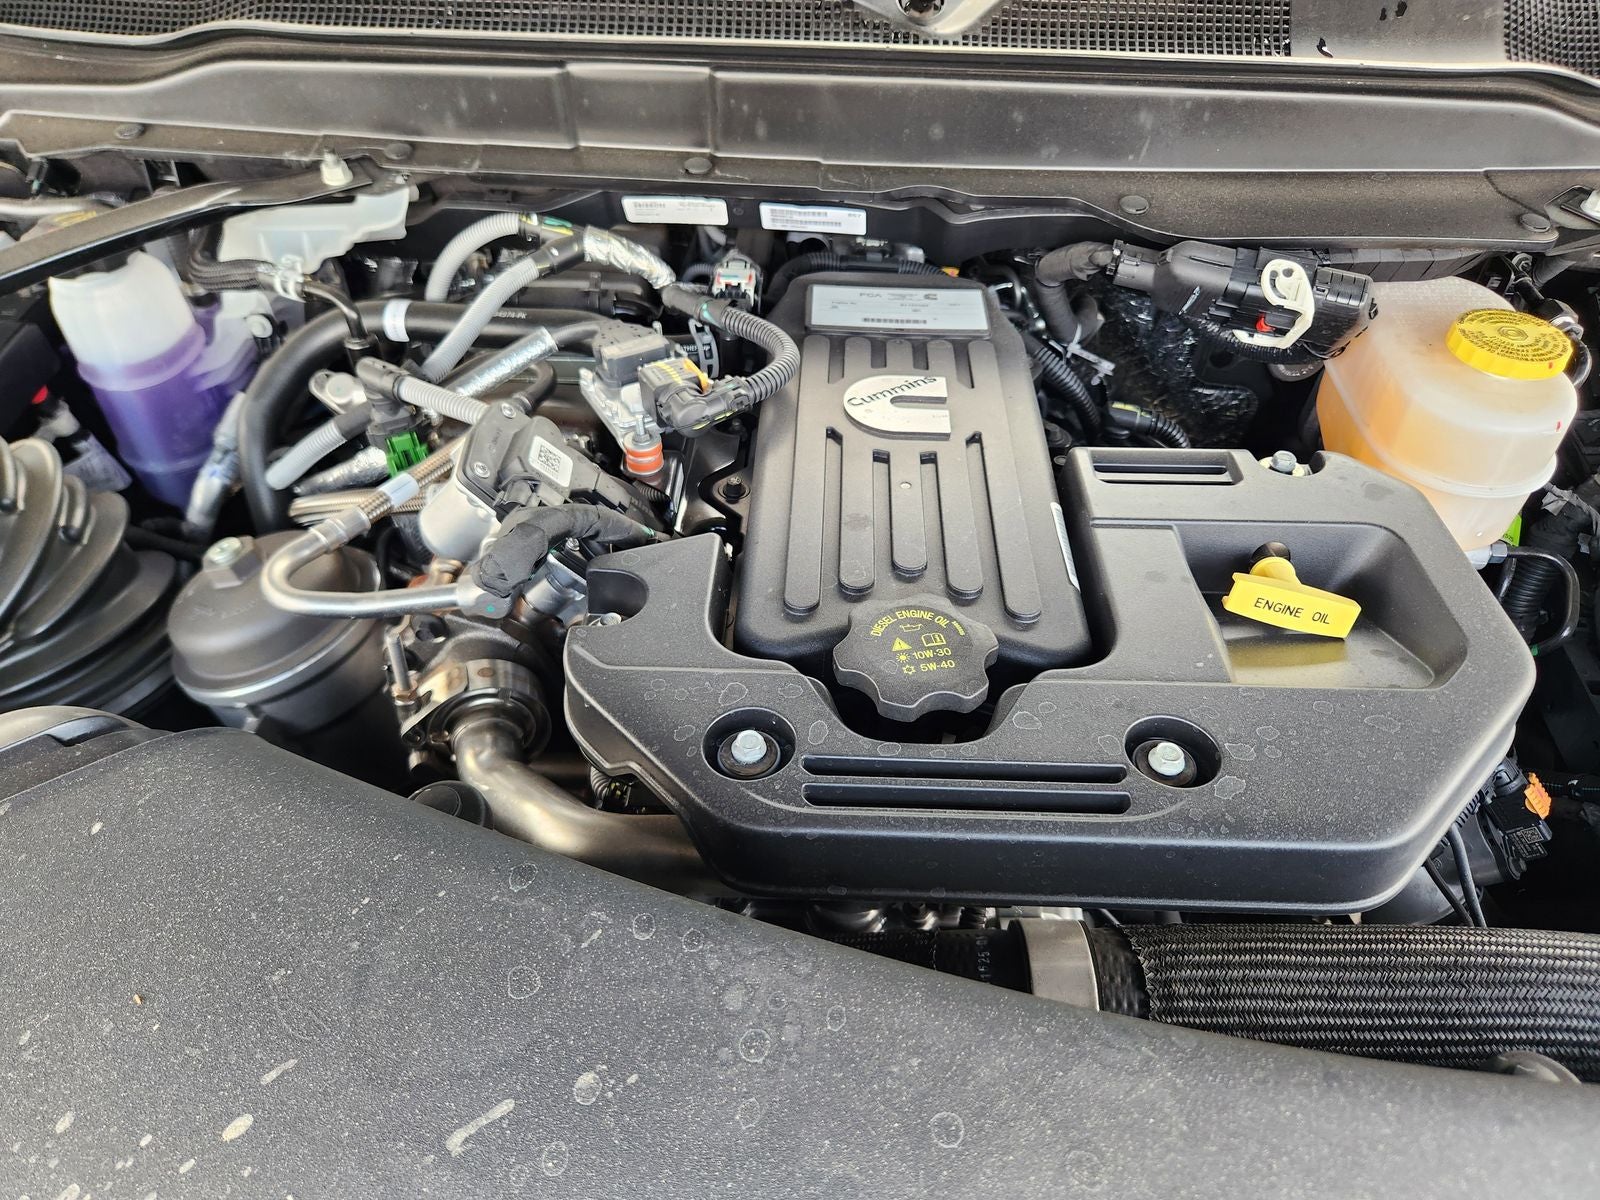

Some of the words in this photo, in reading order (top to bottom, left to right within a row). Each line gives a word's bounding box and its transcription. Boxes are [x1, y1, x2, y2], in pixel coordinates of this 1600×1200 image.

[847, 376, 937, 406] Cummins
[870, 615, 897, 637] DIESEL
[895, 609, 934, 620] ENGINE
[935, 615, 950, 629] OIL
[1254, 597, 1304, 618] ENGINE
[1312, 612, 1330, 625] OIL
[912, 647, 952, 660] 10W-30
[920, 660, 955, 672] 5W-40
